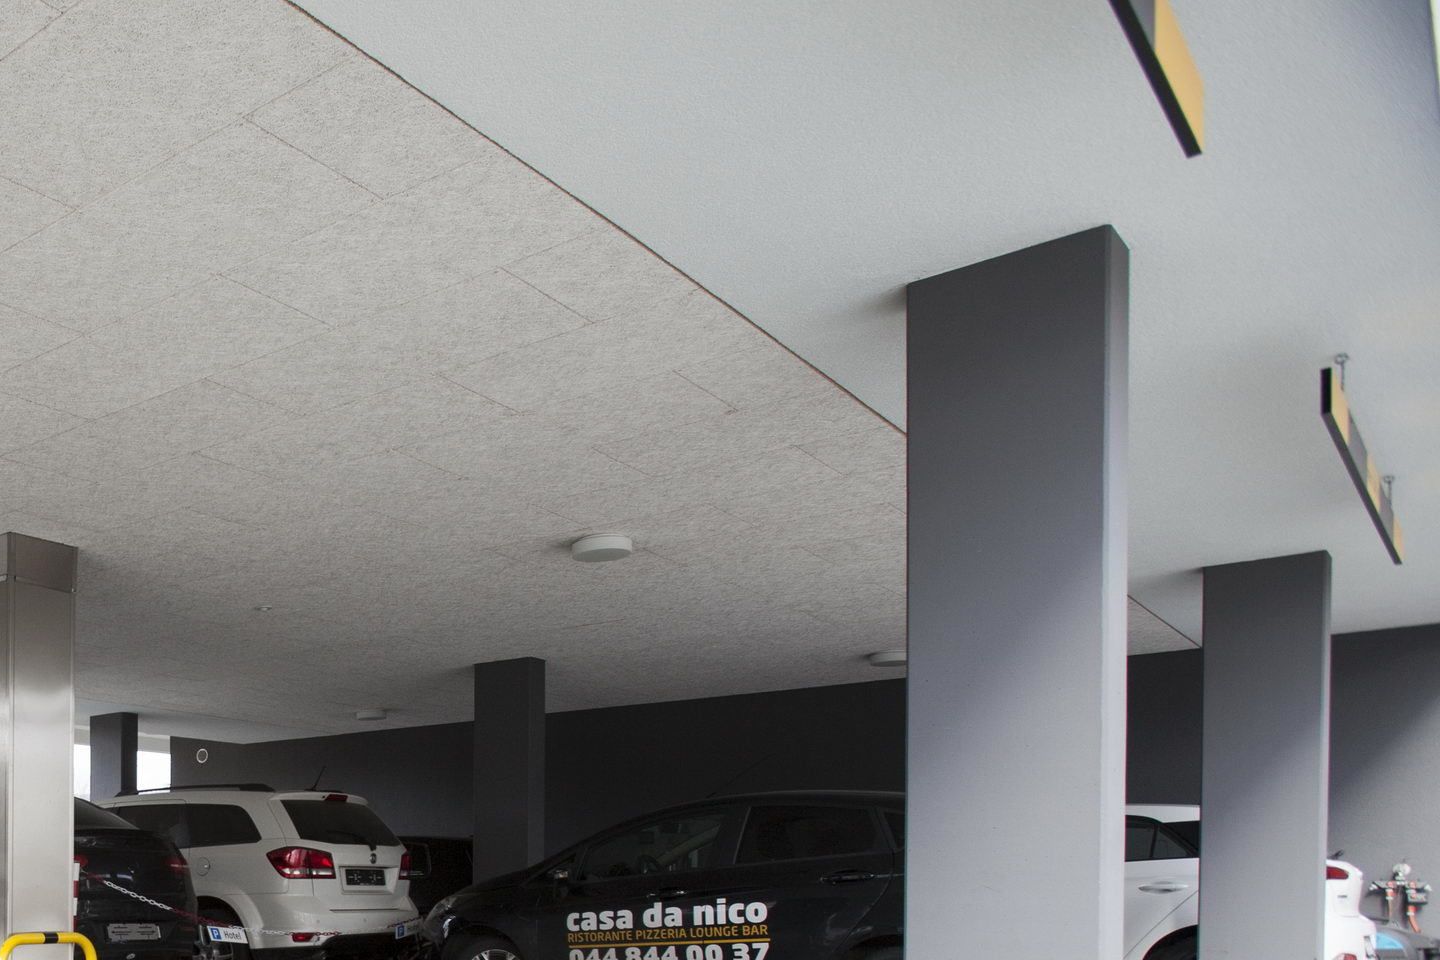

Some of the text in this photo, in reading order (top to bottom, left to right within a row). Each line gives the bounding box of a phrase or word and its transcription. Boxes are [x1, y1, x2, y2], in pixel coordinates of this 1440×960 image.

[566, 897, 768, 932] casa da nico
[223, 930, 242, 940] Hotel
[567, 925, 768, 943] RISTORANTE PIZZERIA LOUNGE BAR
